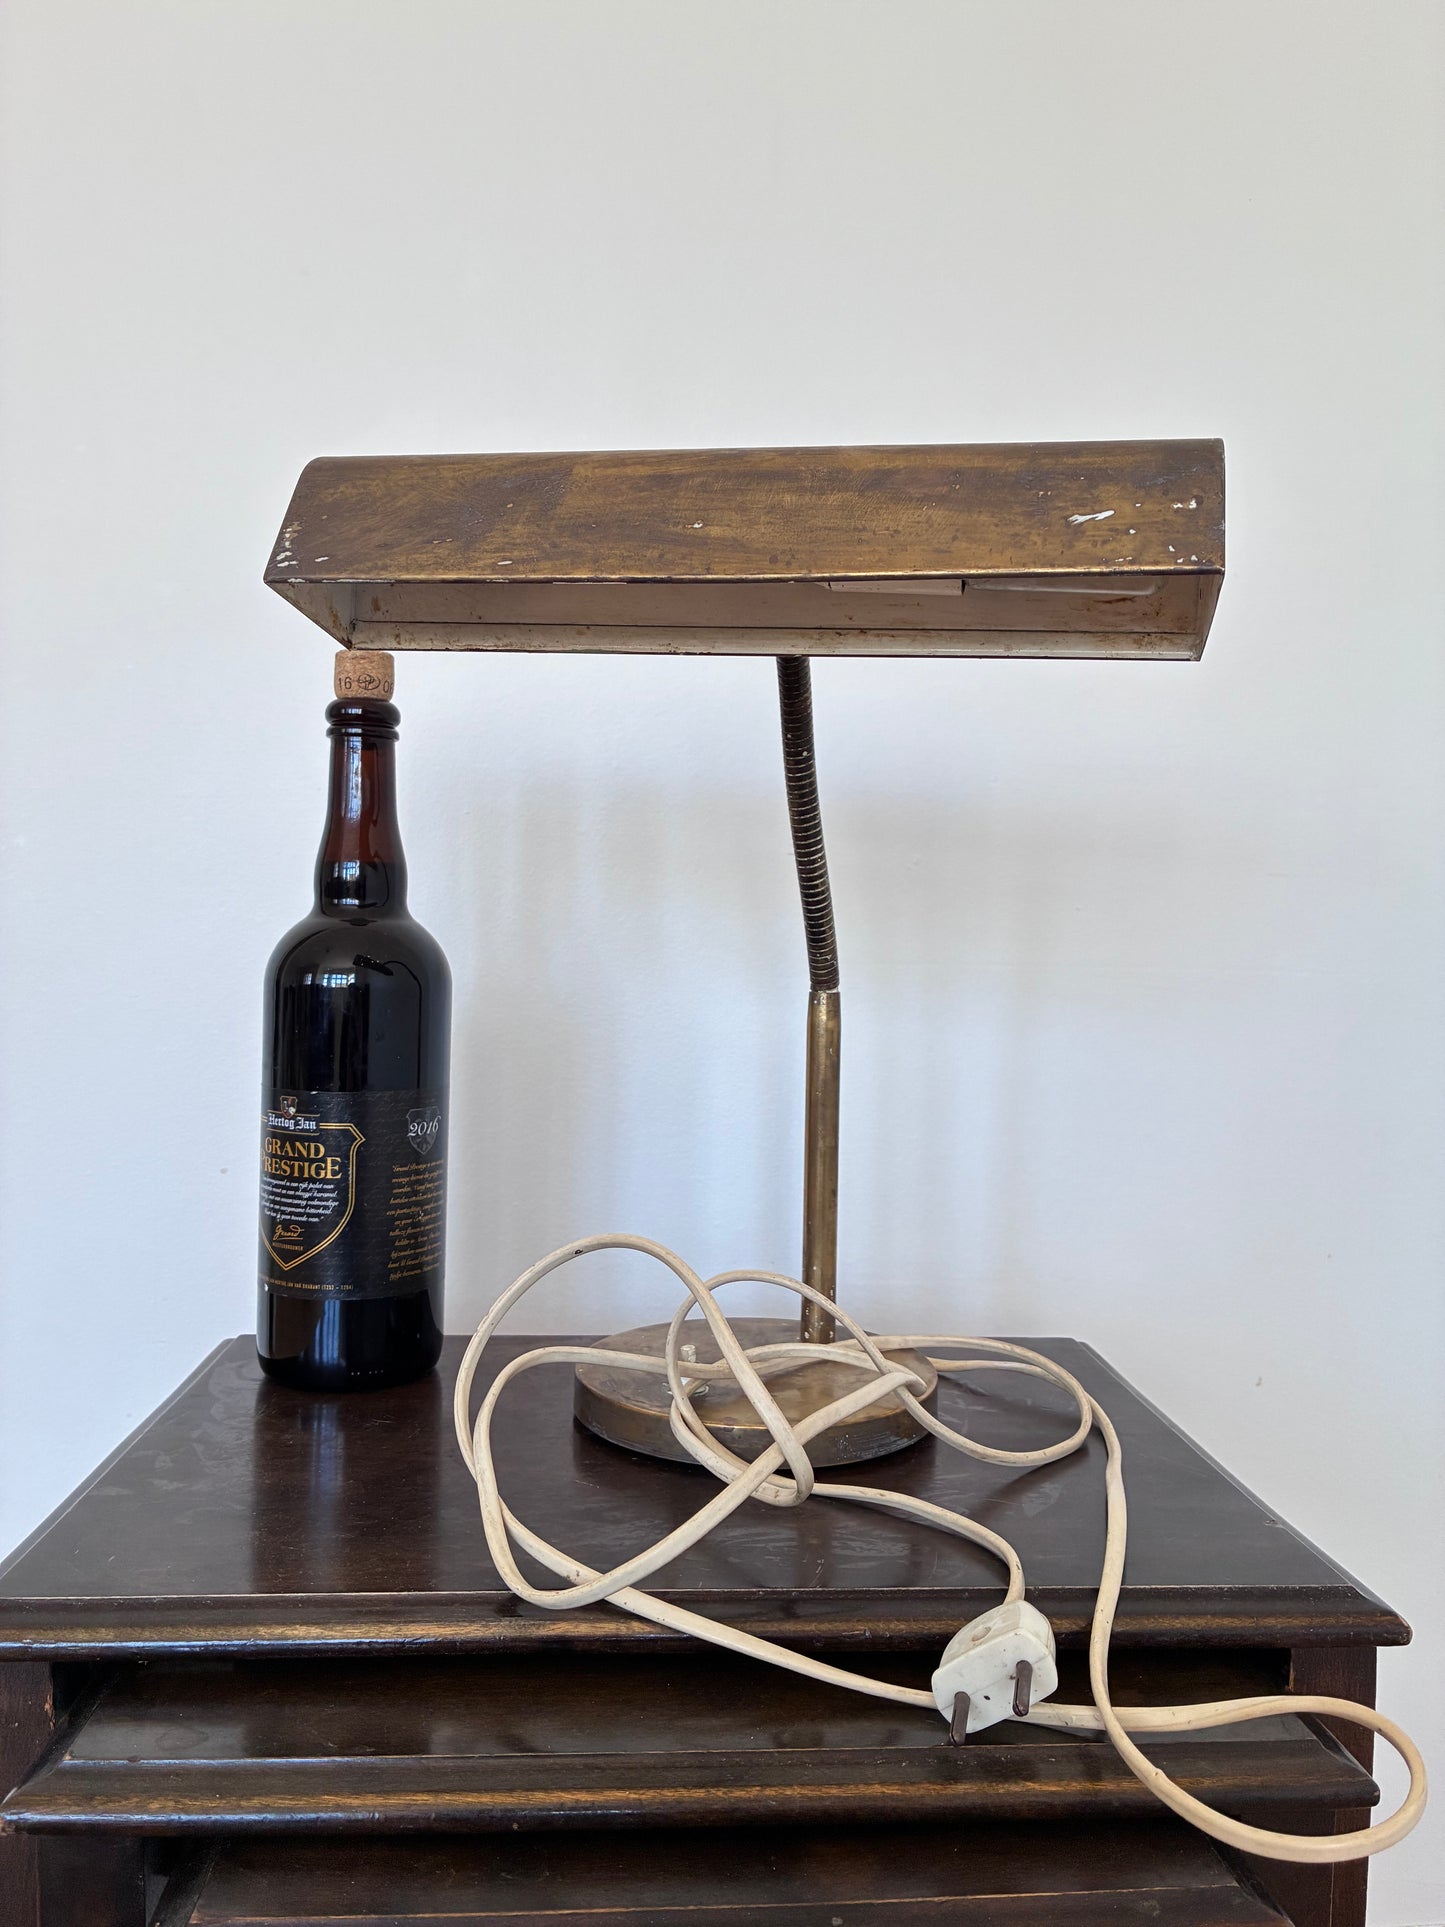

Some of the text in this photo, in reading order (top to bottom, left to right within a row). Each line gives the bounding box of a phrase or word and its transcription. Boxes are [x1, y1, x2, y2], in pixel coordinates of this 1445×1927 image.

[338, 676, 352, 690] 16
[269, 1113, 317, 1131] Hertog Jan
[407, 1115, 442, 1137] 2016
[265, 1137, 325, 1158] GRAND
